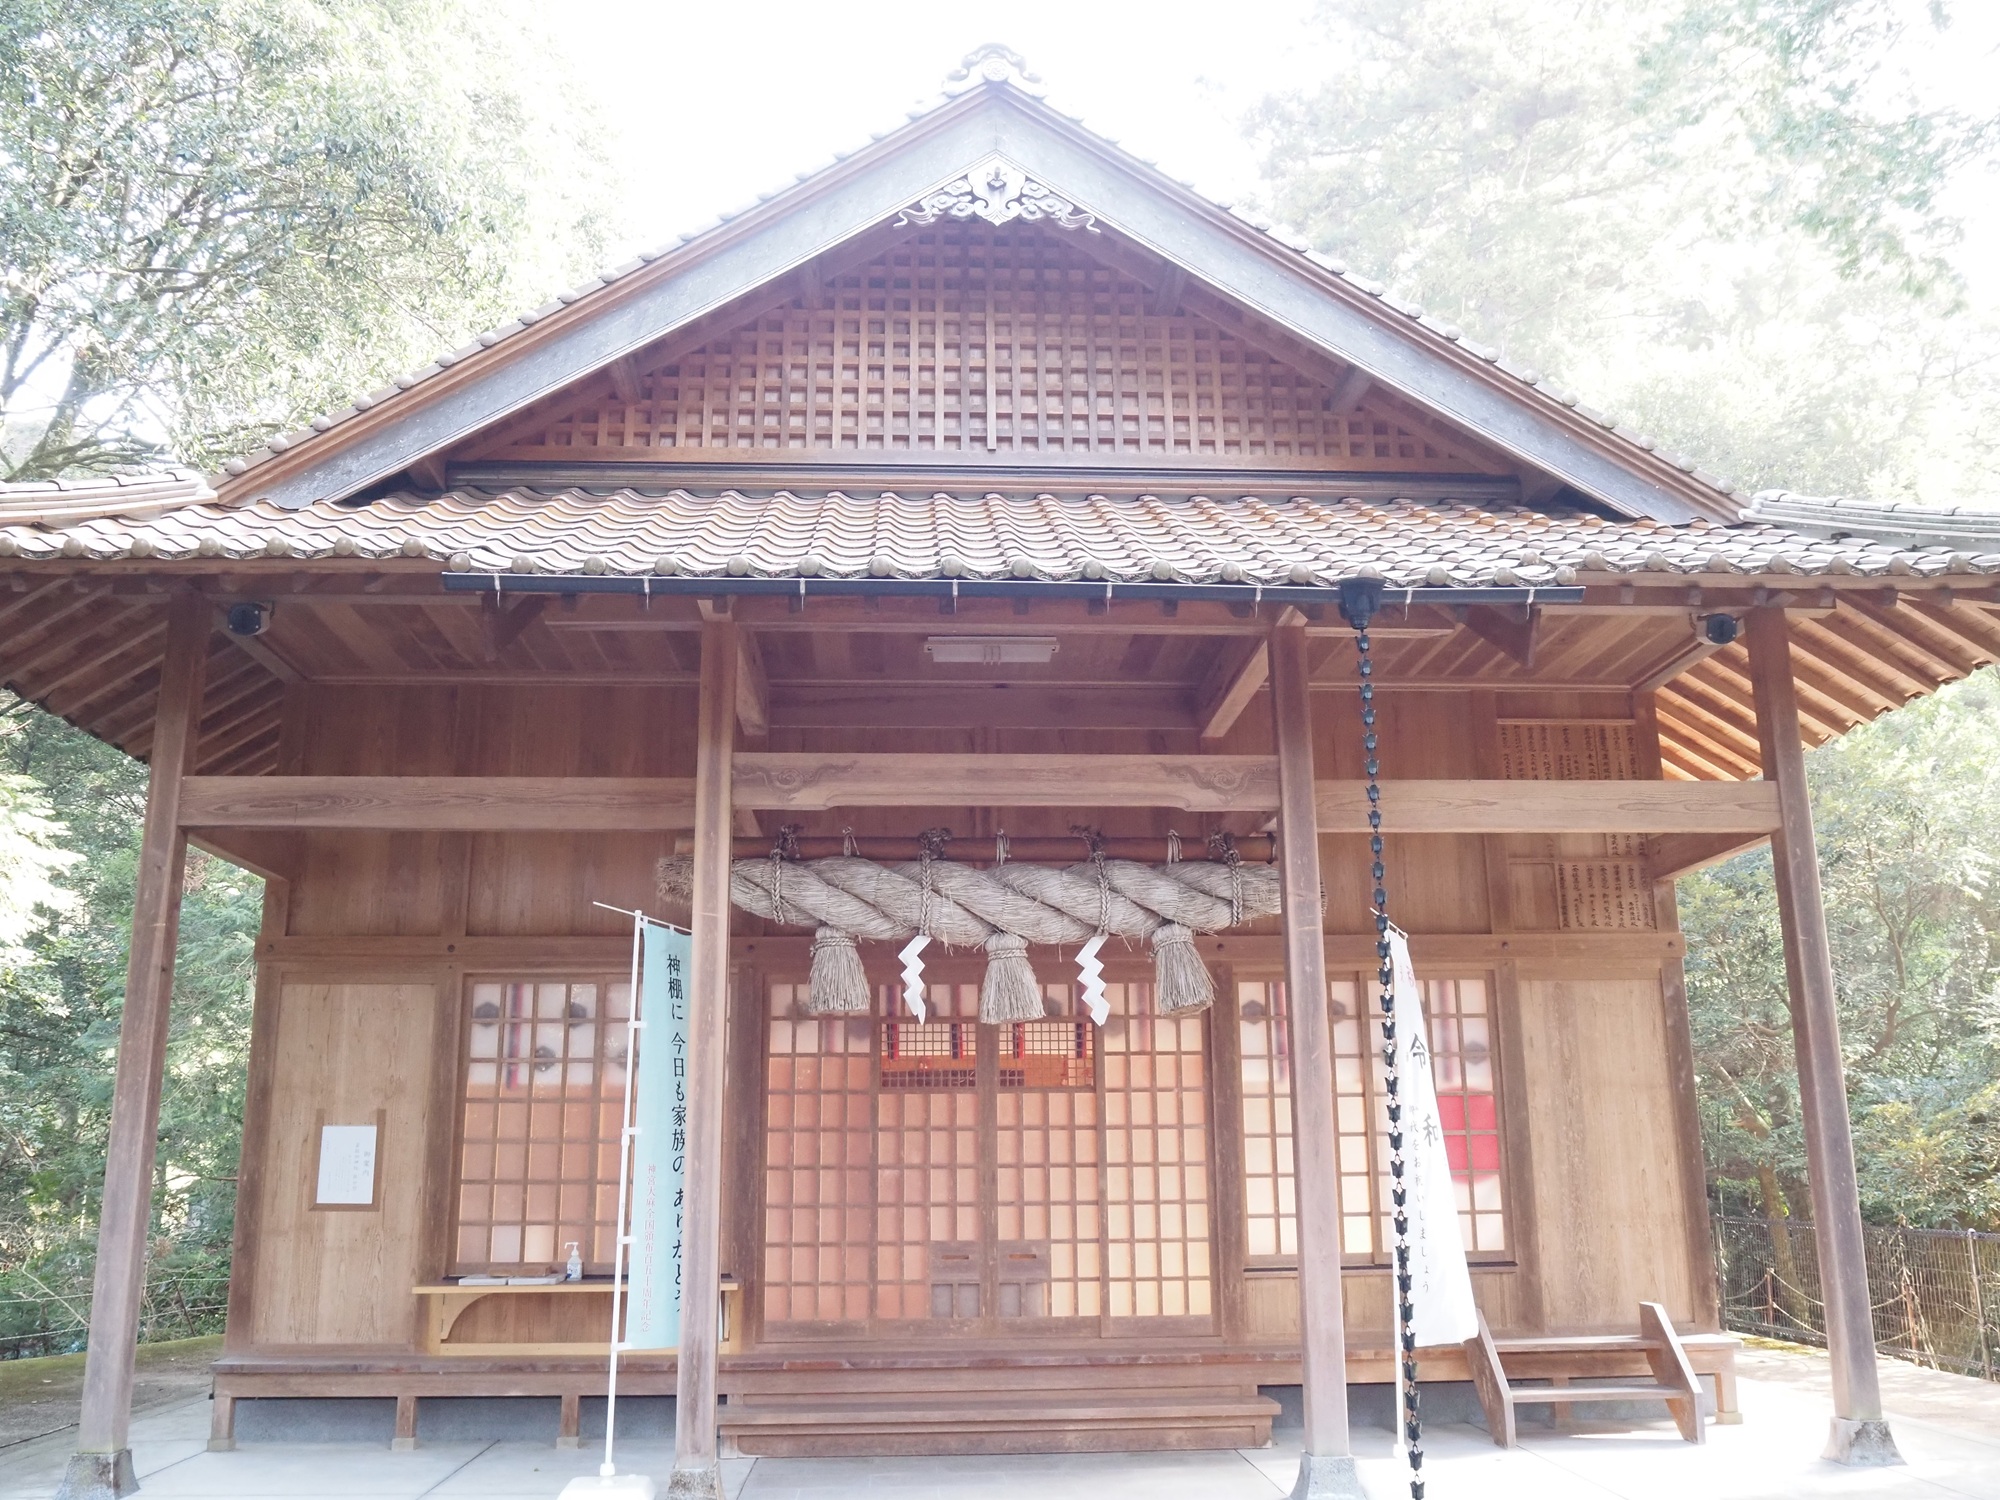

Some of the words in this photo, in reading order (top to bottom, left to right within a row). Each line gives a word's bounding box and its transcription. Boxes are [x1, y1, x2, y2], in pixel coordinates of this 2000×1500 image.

[666, 954, 684, 1021] 神棚に
[670, 1032, 687, 1175] 今日も家族の
[1409, 1032, 1440, 1148] 令和
